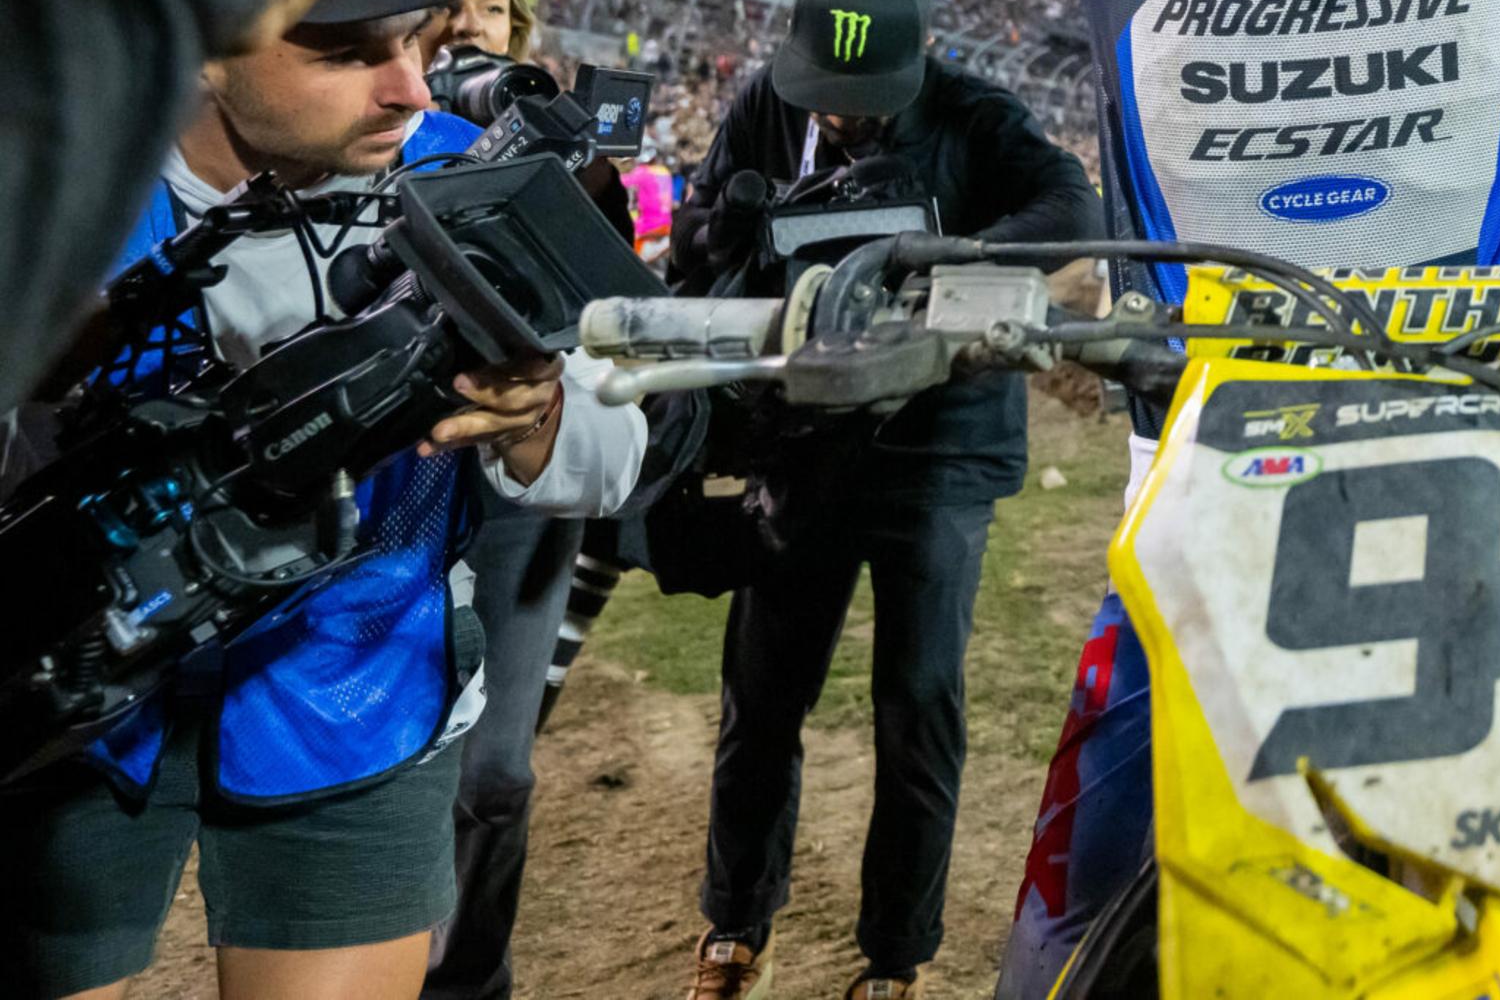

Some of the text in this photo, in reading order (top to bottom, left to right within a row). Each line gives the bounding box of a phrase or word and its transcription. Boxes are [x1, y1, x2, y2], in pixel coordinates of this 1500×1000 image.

[1180, 41, 1460, 104] SUZUKI
[1188, 108, 1453, 162] ECSTAR
[1268, 187, 1376, 210] CYCLE GEAR
[264, 411, 334, 461] Canon
[1241, 455, 1305, 478] AMA
